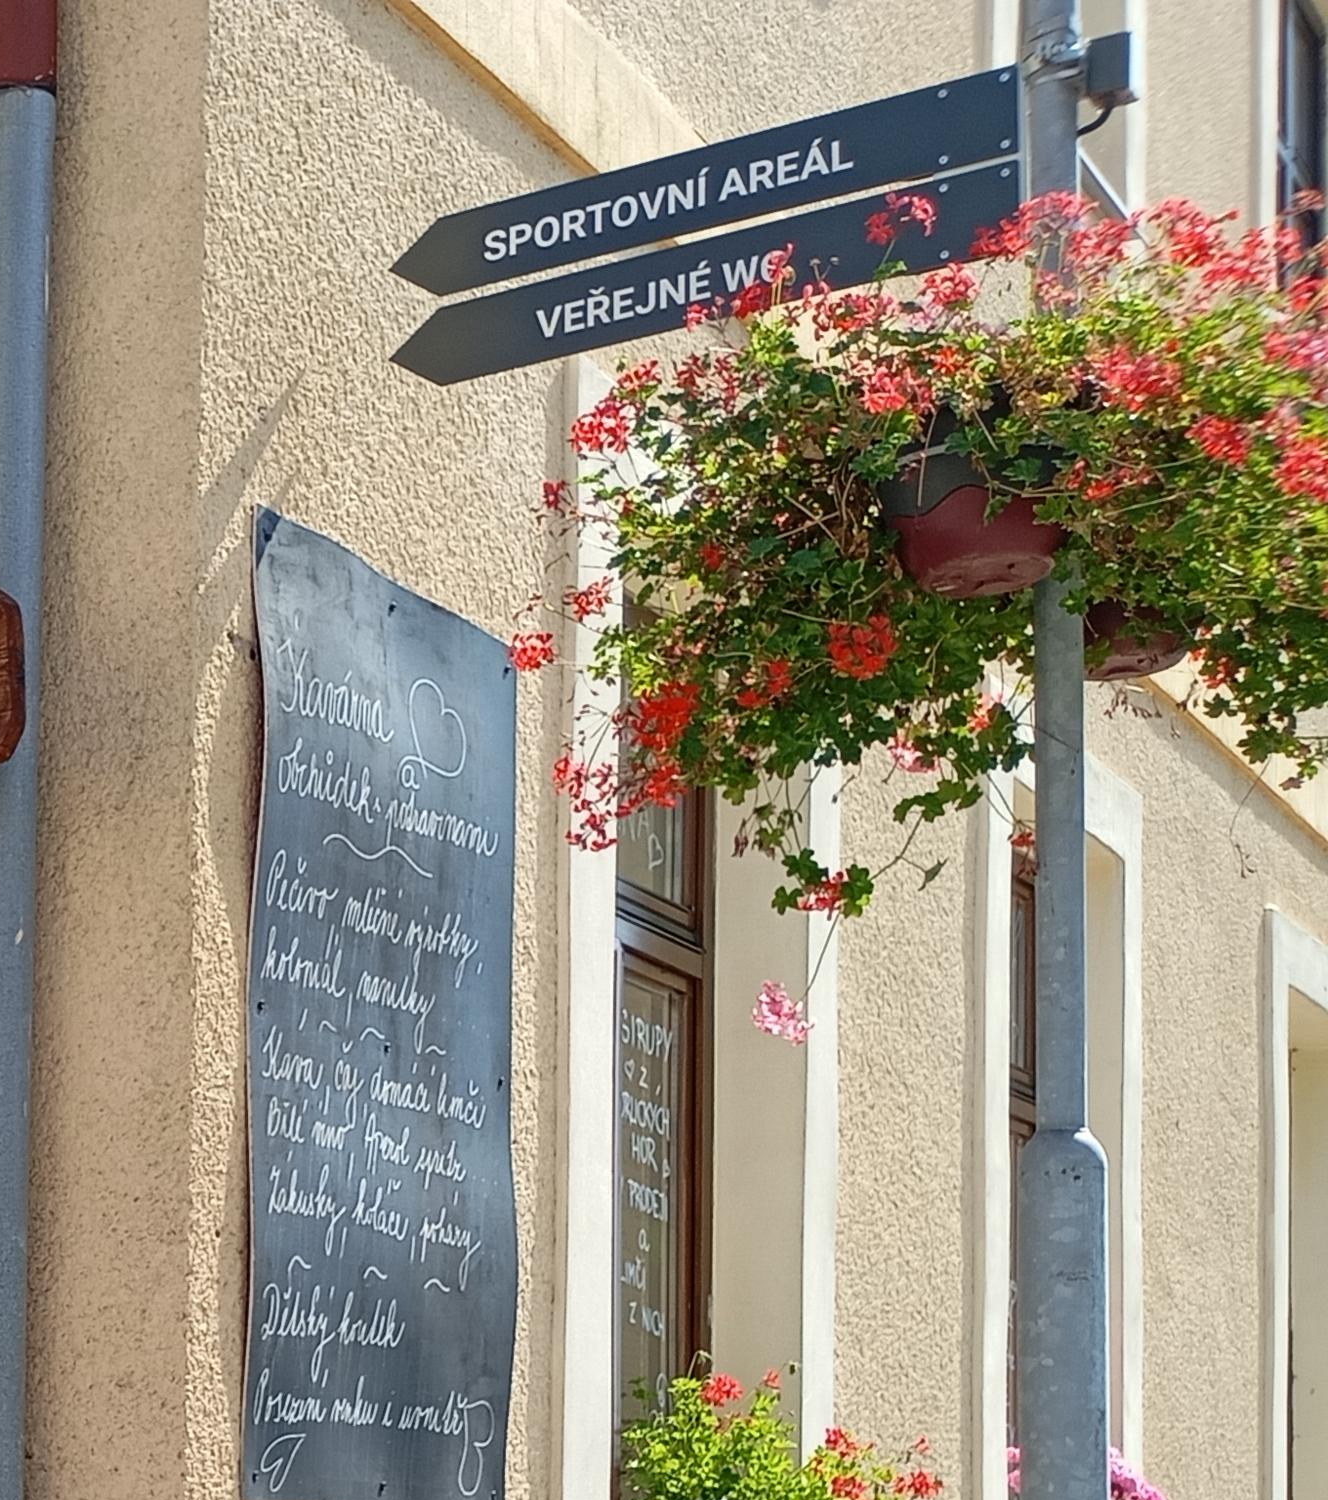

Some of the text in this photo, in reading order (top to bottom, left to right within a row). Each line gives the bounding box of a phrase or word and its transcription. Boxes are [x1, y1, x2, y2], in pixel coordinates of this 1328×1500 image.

[482, 137, 854, 263] SPORTOVNÍ AREÁL
[535, 258, 712, 340] VEŘEJNÉ
